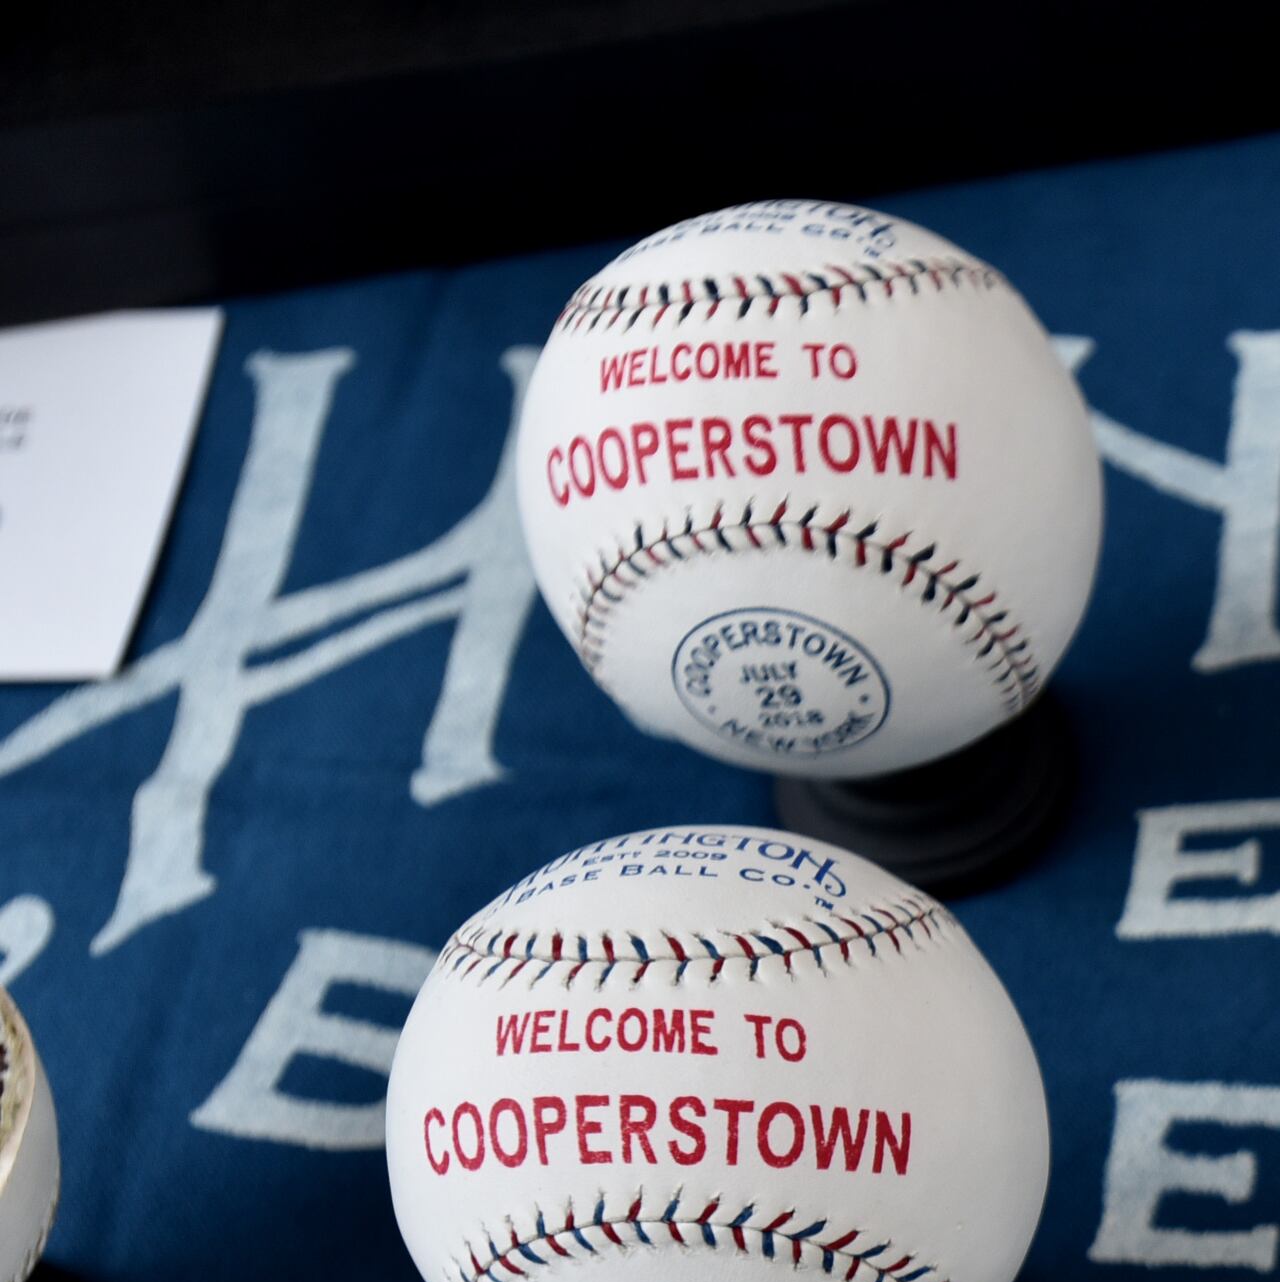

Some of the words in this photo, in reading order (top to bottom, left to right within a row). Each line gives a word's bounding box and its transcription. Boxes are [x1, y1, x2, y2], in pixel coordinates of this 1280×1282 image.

[600, 341, 778, 395] WELCOME
[802, 342, 858, 381] TO
[547, 414, 958, 508] COOPERSTOWN
[684, 620, 868, 697] COOPERSTOWN
[755, 684, 803, 709] 29
[653, 849, 728, 862] 2009
[515, 867, 602, 906] BASE
[619, 864, 719, 878] BALL
[739, 866, 812, 890] CO.
[497, 1007, 718, 1056] WELCOME
[744, 1014, 807, 1062] TO
[423, 1094, 911, 1176] COOPERSTOWN
